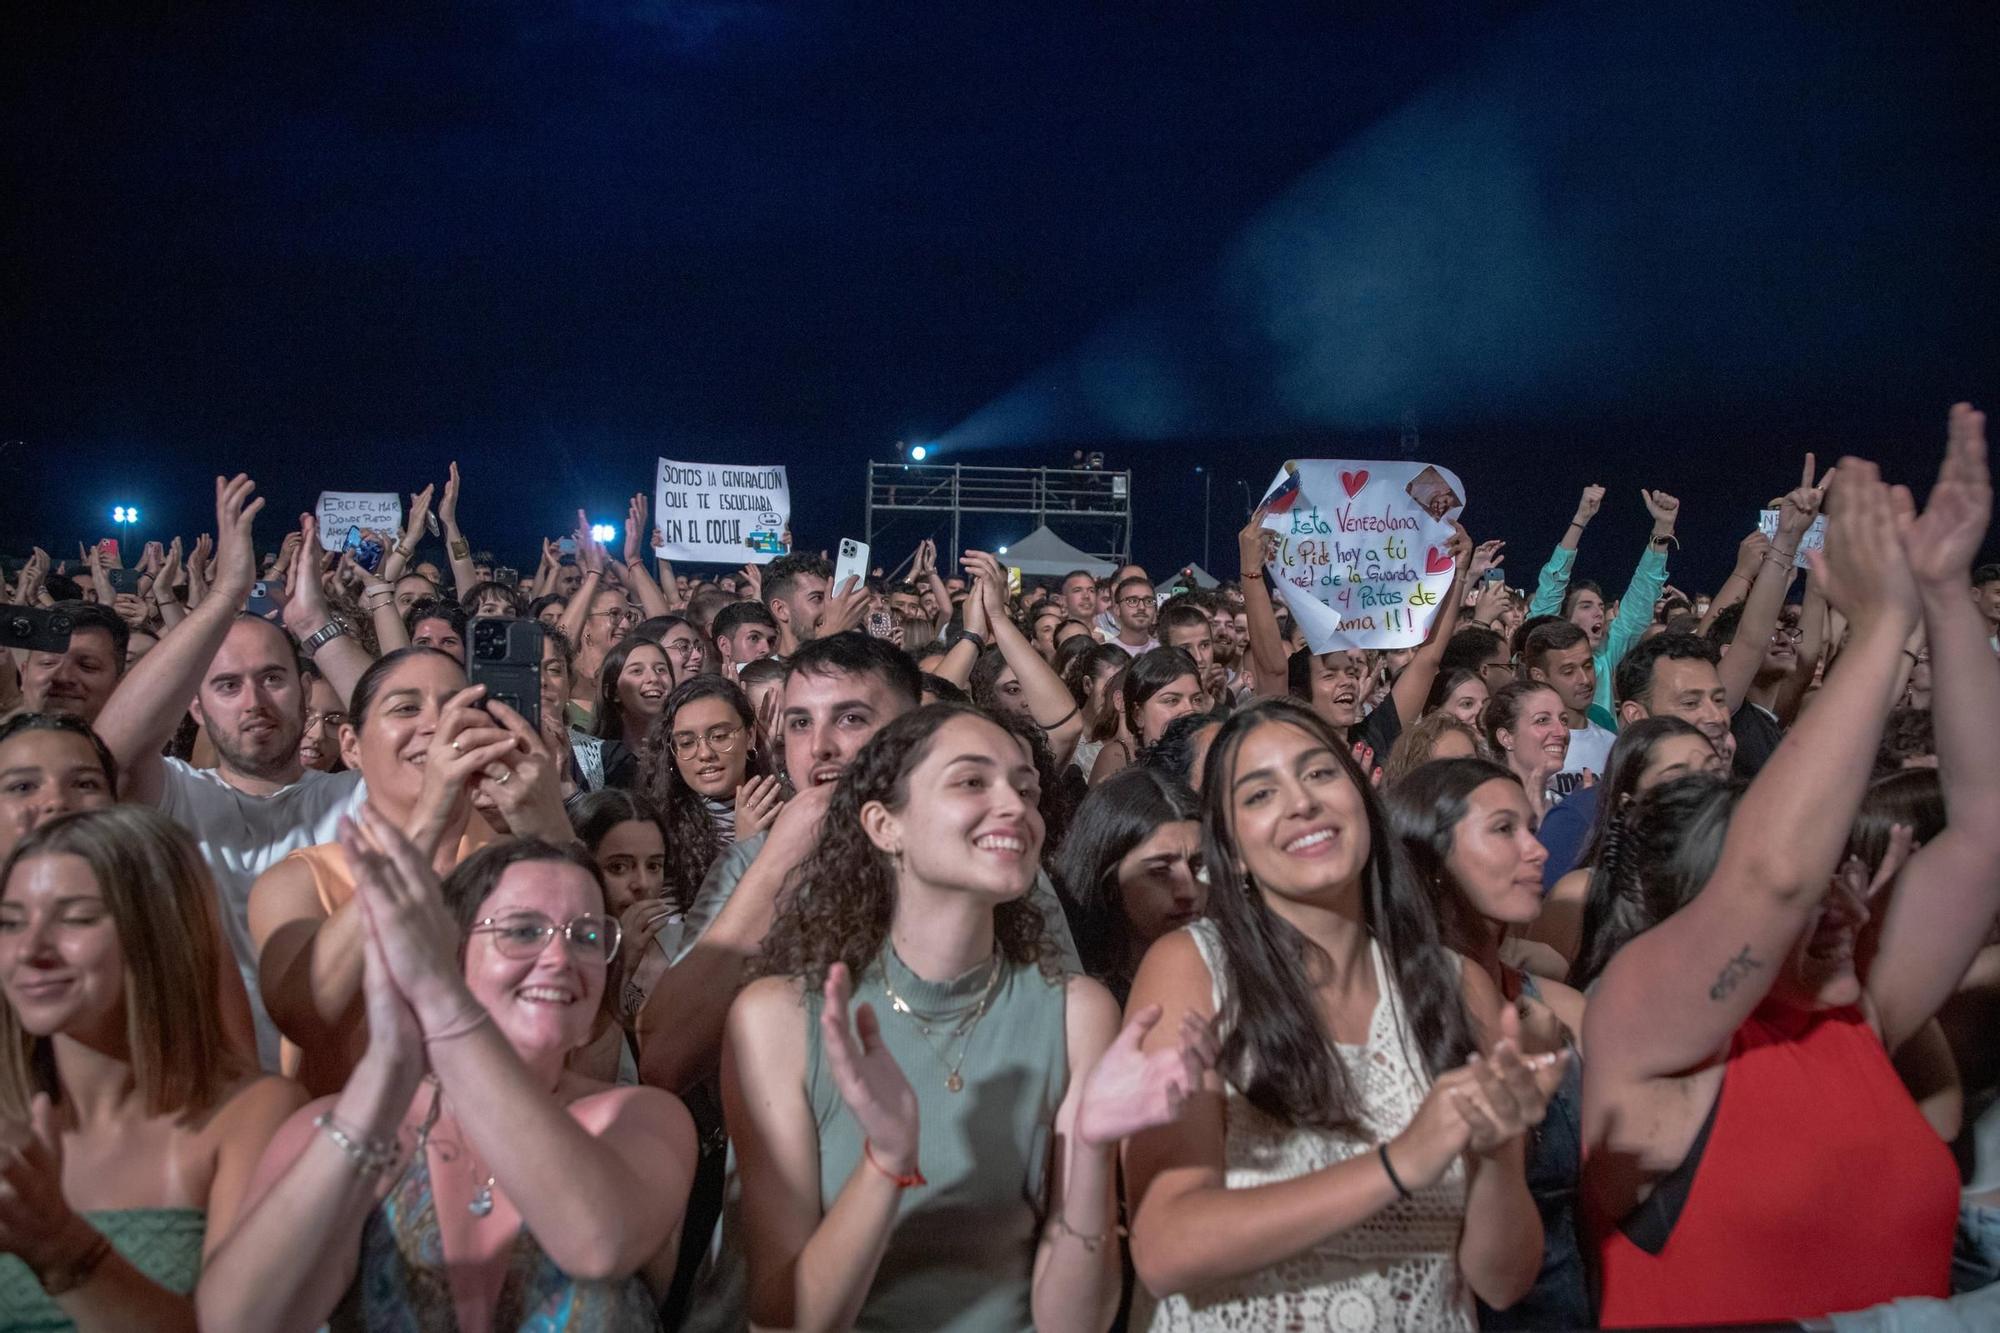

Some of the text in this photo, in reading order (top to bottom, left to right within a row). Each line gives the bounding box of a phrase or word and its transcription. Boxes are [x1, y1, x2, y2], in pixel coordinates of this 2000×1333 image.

[663, 465, 702, 487] SOMOS
[722, 468, 783, 489] GENERACIÓN
[359, 501, 375, 511] EL
[665, 491, 773, 512] QUE TE ESCUCHABA
[667, 519, 742, 544] EN EL COCHE
[1290, 506, 1333, 534] Esta
[1335, 541, 1361, 569] hoy
[1365, 549, 1380, 561] a
[1383, 536, 1407, 560] tú
[1346, 565, 1362, 584] la
[1366, 564, 1420, 583] Guarda
[1338, 587, 1350, 609] 4
[1357, 584, 1403, 609] Patas
